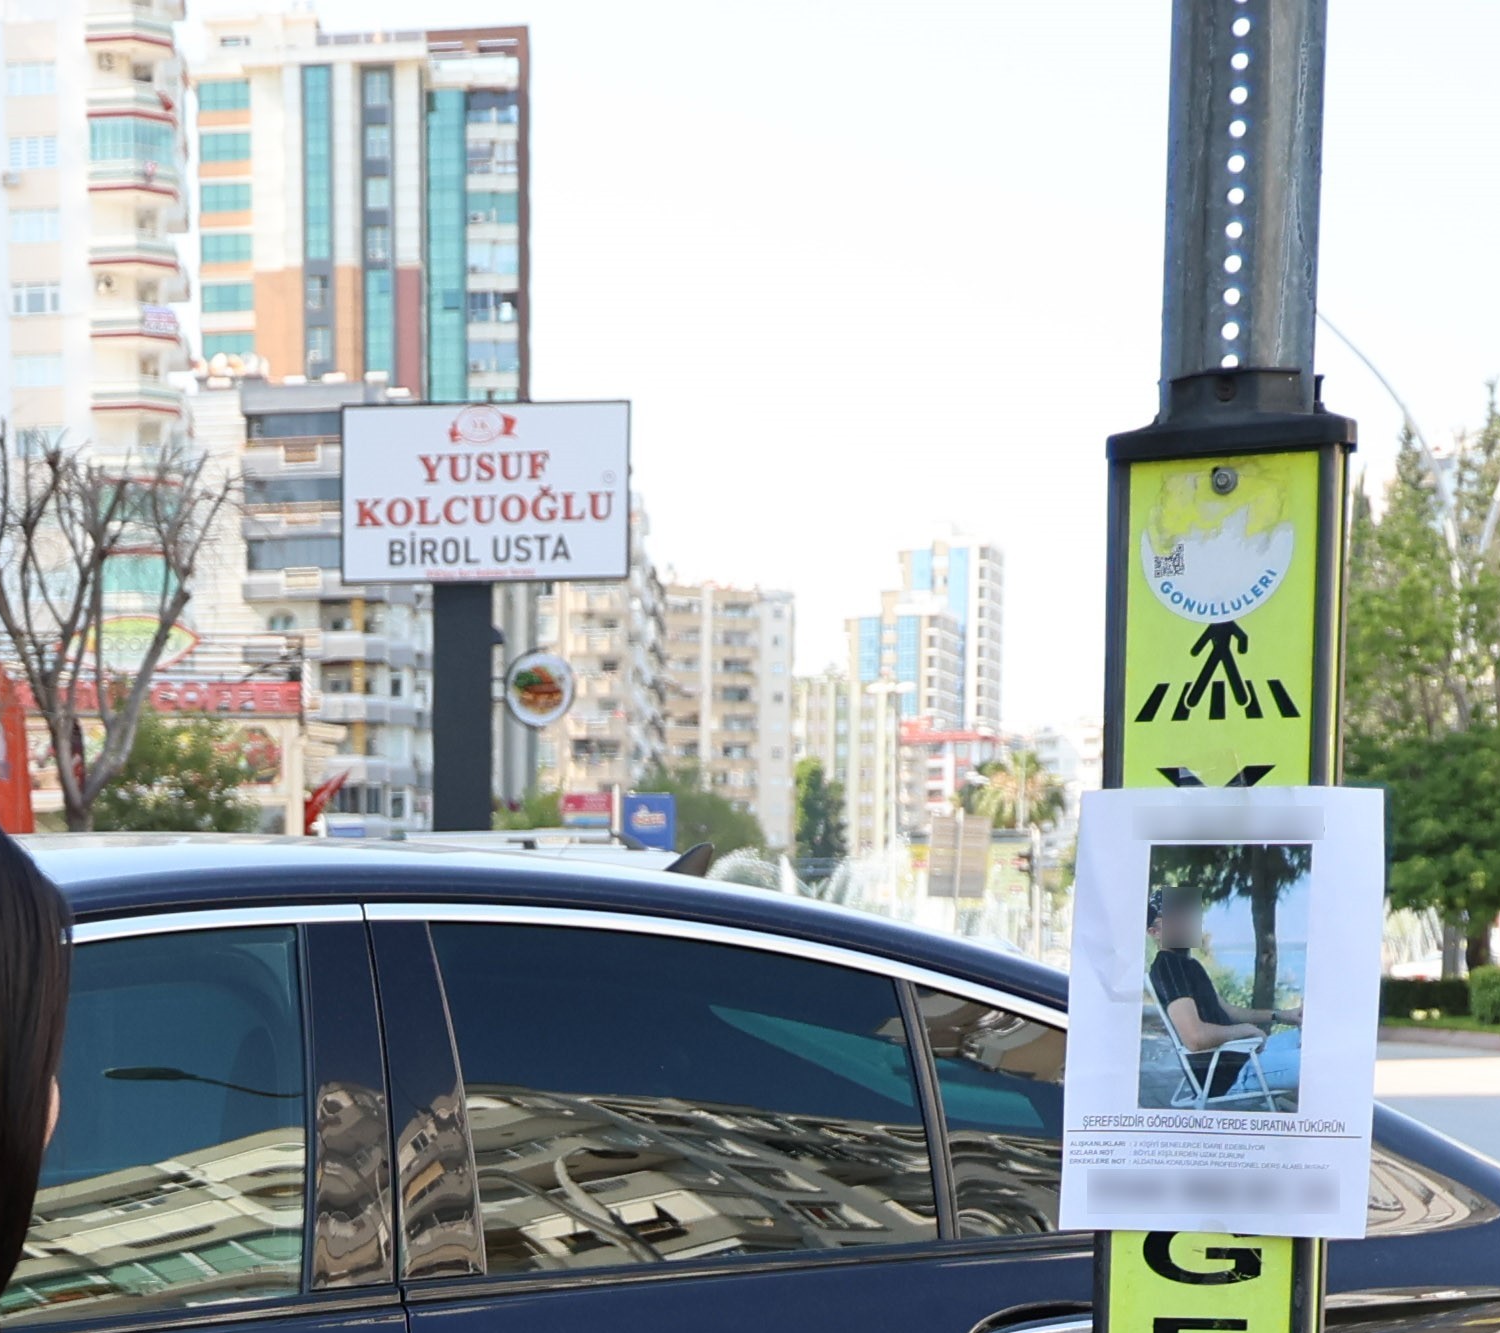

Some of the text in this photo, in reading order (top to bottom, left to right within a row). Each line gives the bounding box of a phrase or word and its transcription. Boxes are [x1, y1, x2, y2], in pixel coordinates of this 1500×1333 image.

[417, 450, 550, 483] YUSUF
[355, 486, 615, 528] KOLCUOĞLU
[388, 531, 572, 567] BİROL USTA
[1083, 1114, 1145, 1130] ŞEREFSİZDİR
[1216, 1118, 1248, 1130] YERDE
[1250, 1119, 1296, 1132] SURATINA
[1299, 1120, 1345, 1133] TÜKÜRÜN
